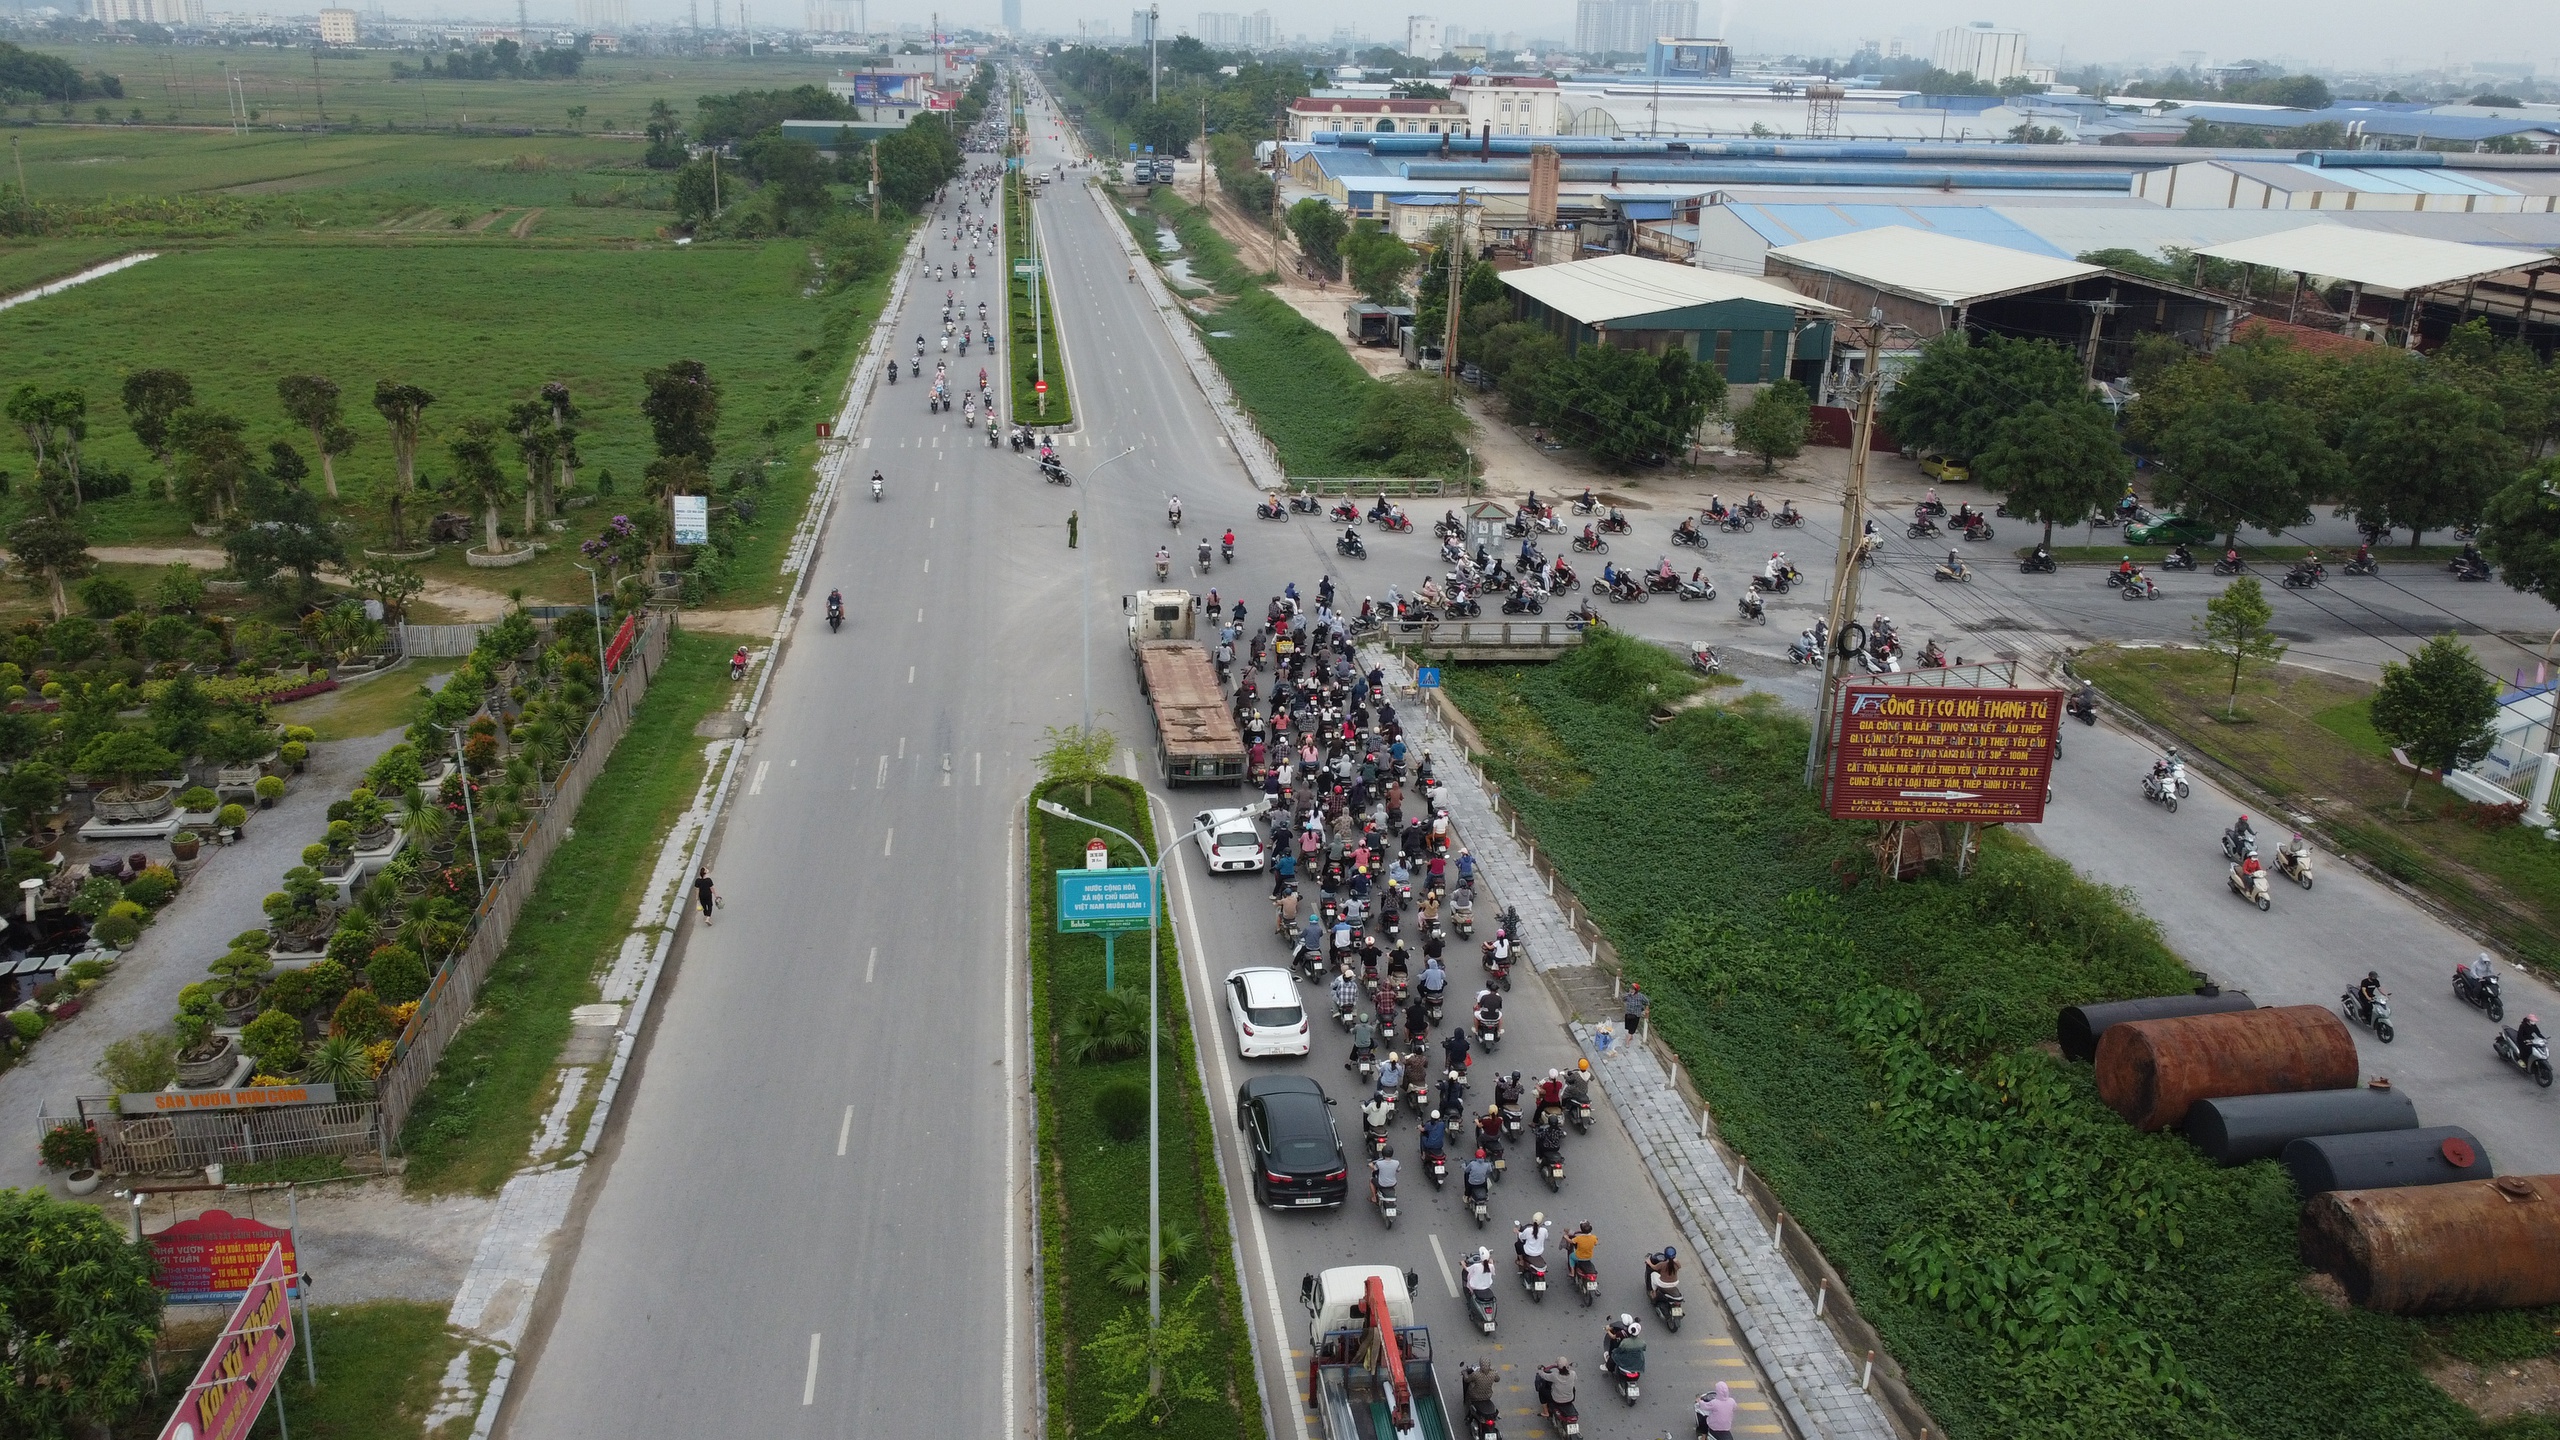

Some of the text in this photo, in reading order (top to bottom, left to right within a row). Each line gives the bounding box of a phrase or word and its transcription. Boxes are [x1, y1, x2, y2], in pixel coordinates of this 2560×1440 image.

[1880, 694, 1915, 715] CÔNG
[1919, 699, 1936, 717] TY
[1957, 696, 1981, 718] KHÍ
[1984, 700, 2027, 719] THANH
[2031, 697, 2048, 718] TÚ
[1859, 721, 1874, 730] GIA
[1877, 719, 1900, 731] CÔNG
[1902, 720, 1913, 731] VÀ
[2021, 721, 2043, 734] THÉP
[1907, 735, 1924, 745] PHA
[2013, 736, 2028, 747] YÊU
[1880, 745, 1898, 757] XUẤT
[1879, 761, 1895, 773] BẢN
[1938, 765, 1956, 775] THEO
[1957, 763, 1971, 775] YÊU
[2000, 767, 2005, 776] 3
[2006, 767, 2014, 776] LY
[2019, 767, 2028, 776] 30
[2029, 767, 2039, 776] LY
[1849, 777, 1870, 786] CUNG
[1905, 778, 1921, 789] LOẠI
[1084, 883, 1136, 892] NƯỚC CỘNG HÒA
[1092, 893, 1103, 902] HỘI
[1105, 892, 1118, 900] CHỦ
[1074, 903, 1088, 911] VIỆT
[244, 1243, 258, 1252] CUNG
